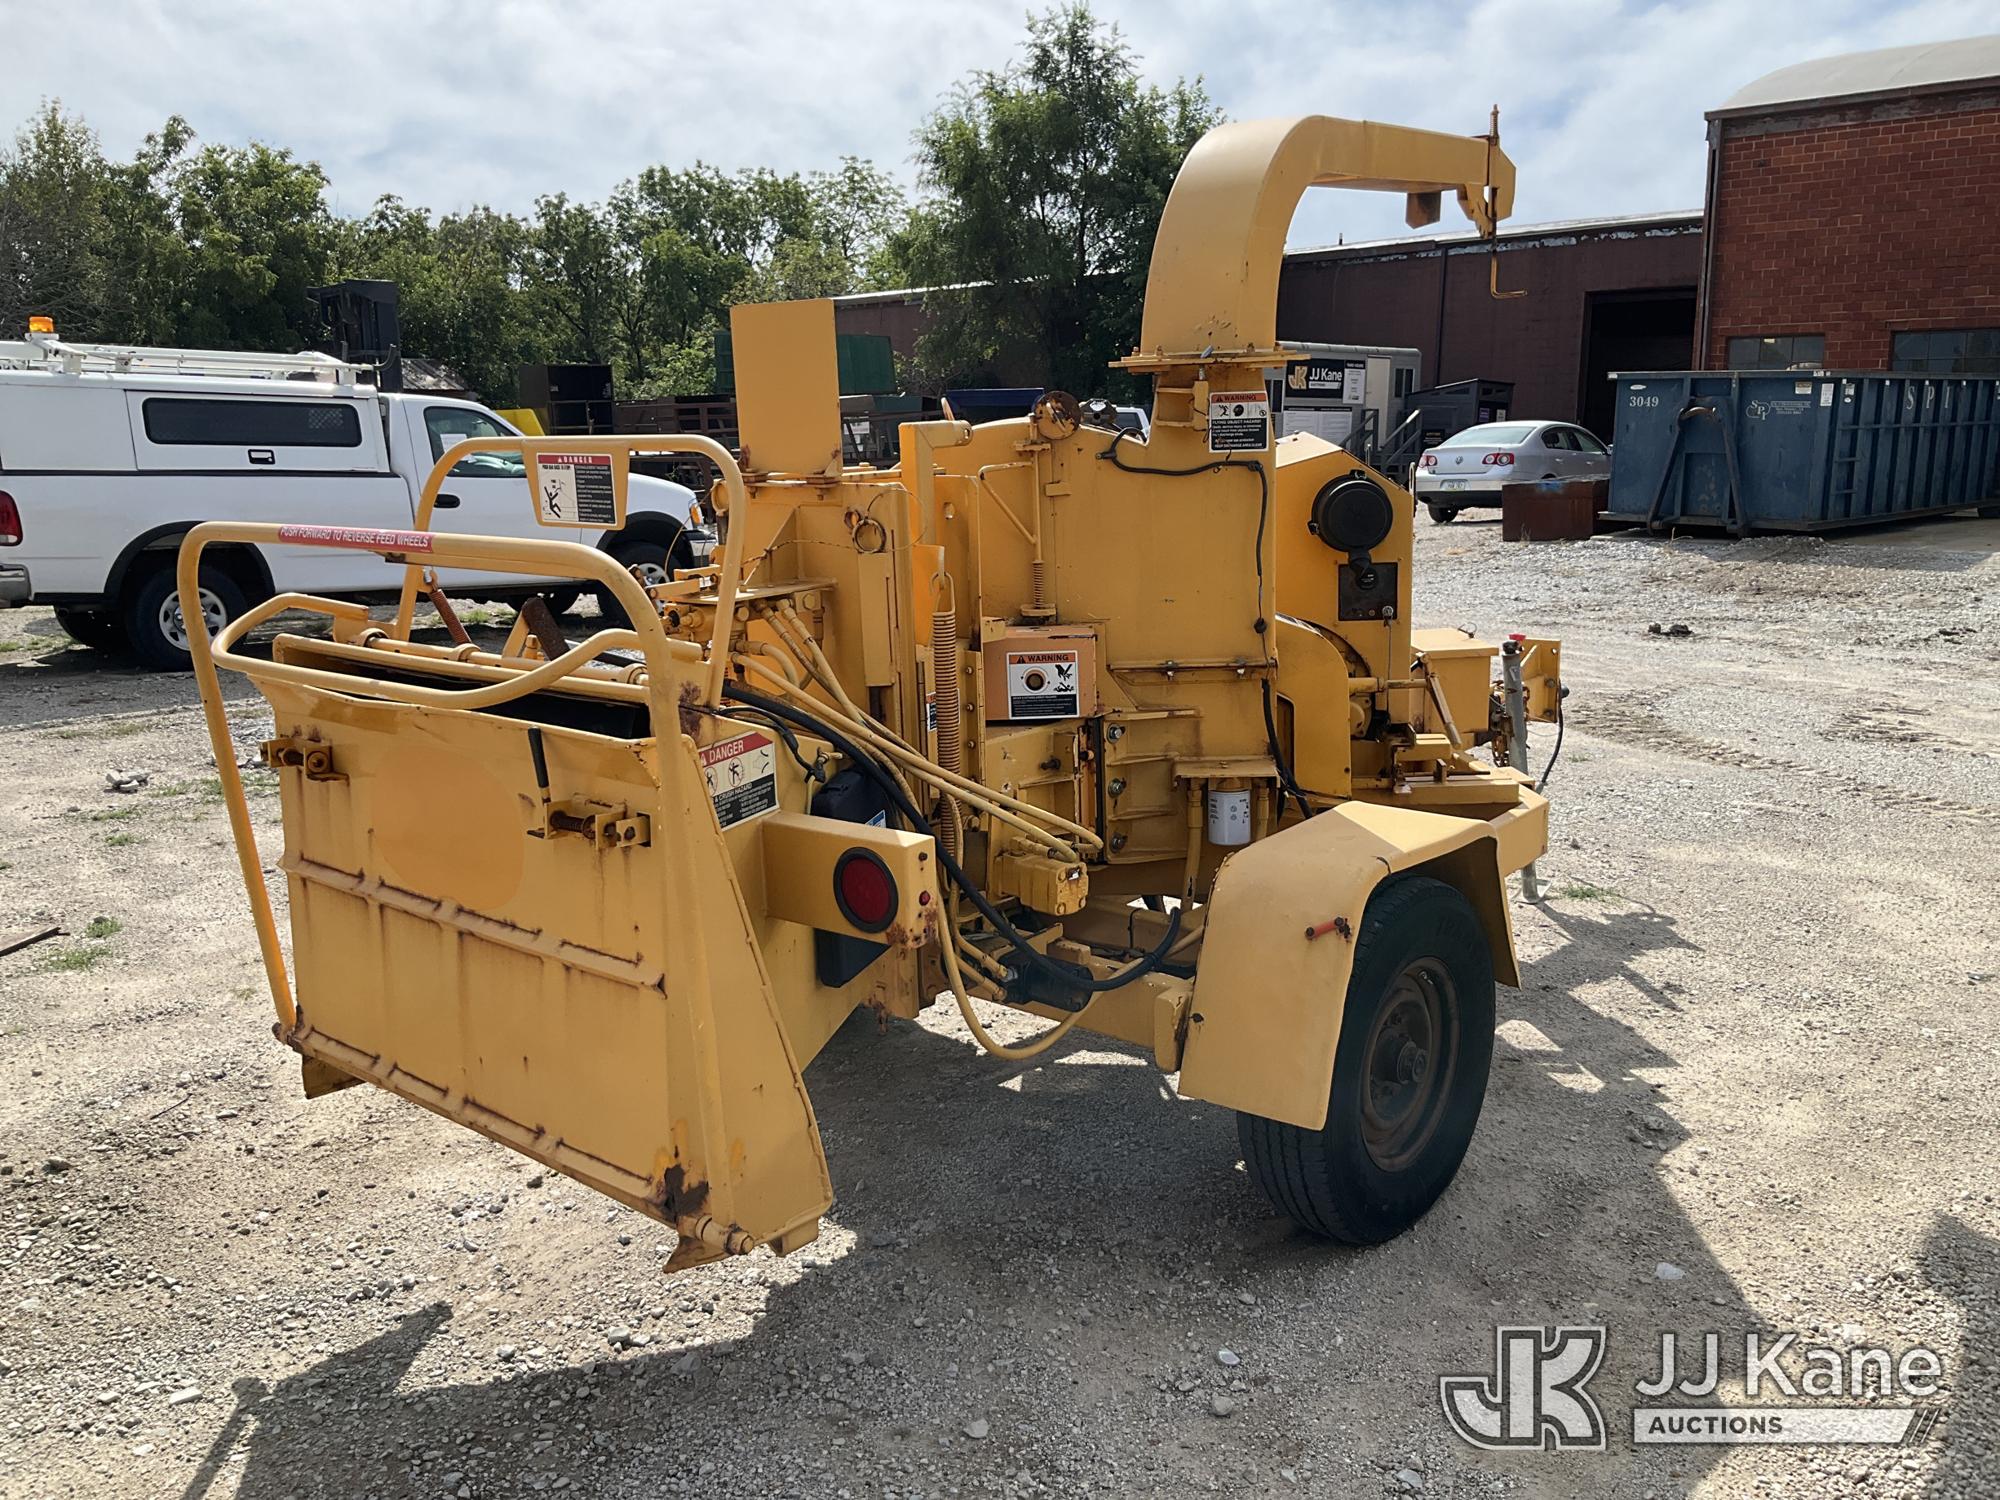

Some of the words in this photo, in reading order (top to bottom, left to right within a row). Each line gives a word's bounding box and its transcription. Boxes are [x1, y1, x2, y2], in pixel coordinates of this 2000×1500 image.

[1309, 367, 1320, 380] JJ
[1321, 367, 1343, 381] Kane
[1629, 395, 1659, 407] 3049
[563, 456, 593, 464] DANGER
[280, 526, 298, 537] PUSH
[299, 527, 331, 540] FORWARD
[333, 529, 342, 541] TO
[343, 530, 375, 544] REVERSE
[376, 533, 396, 545] FEED
[397, 535, 429, 547] WHEELS
[1027, 654, 1069, 662] WARNING
[709, 740, 744, 763] DANGER
